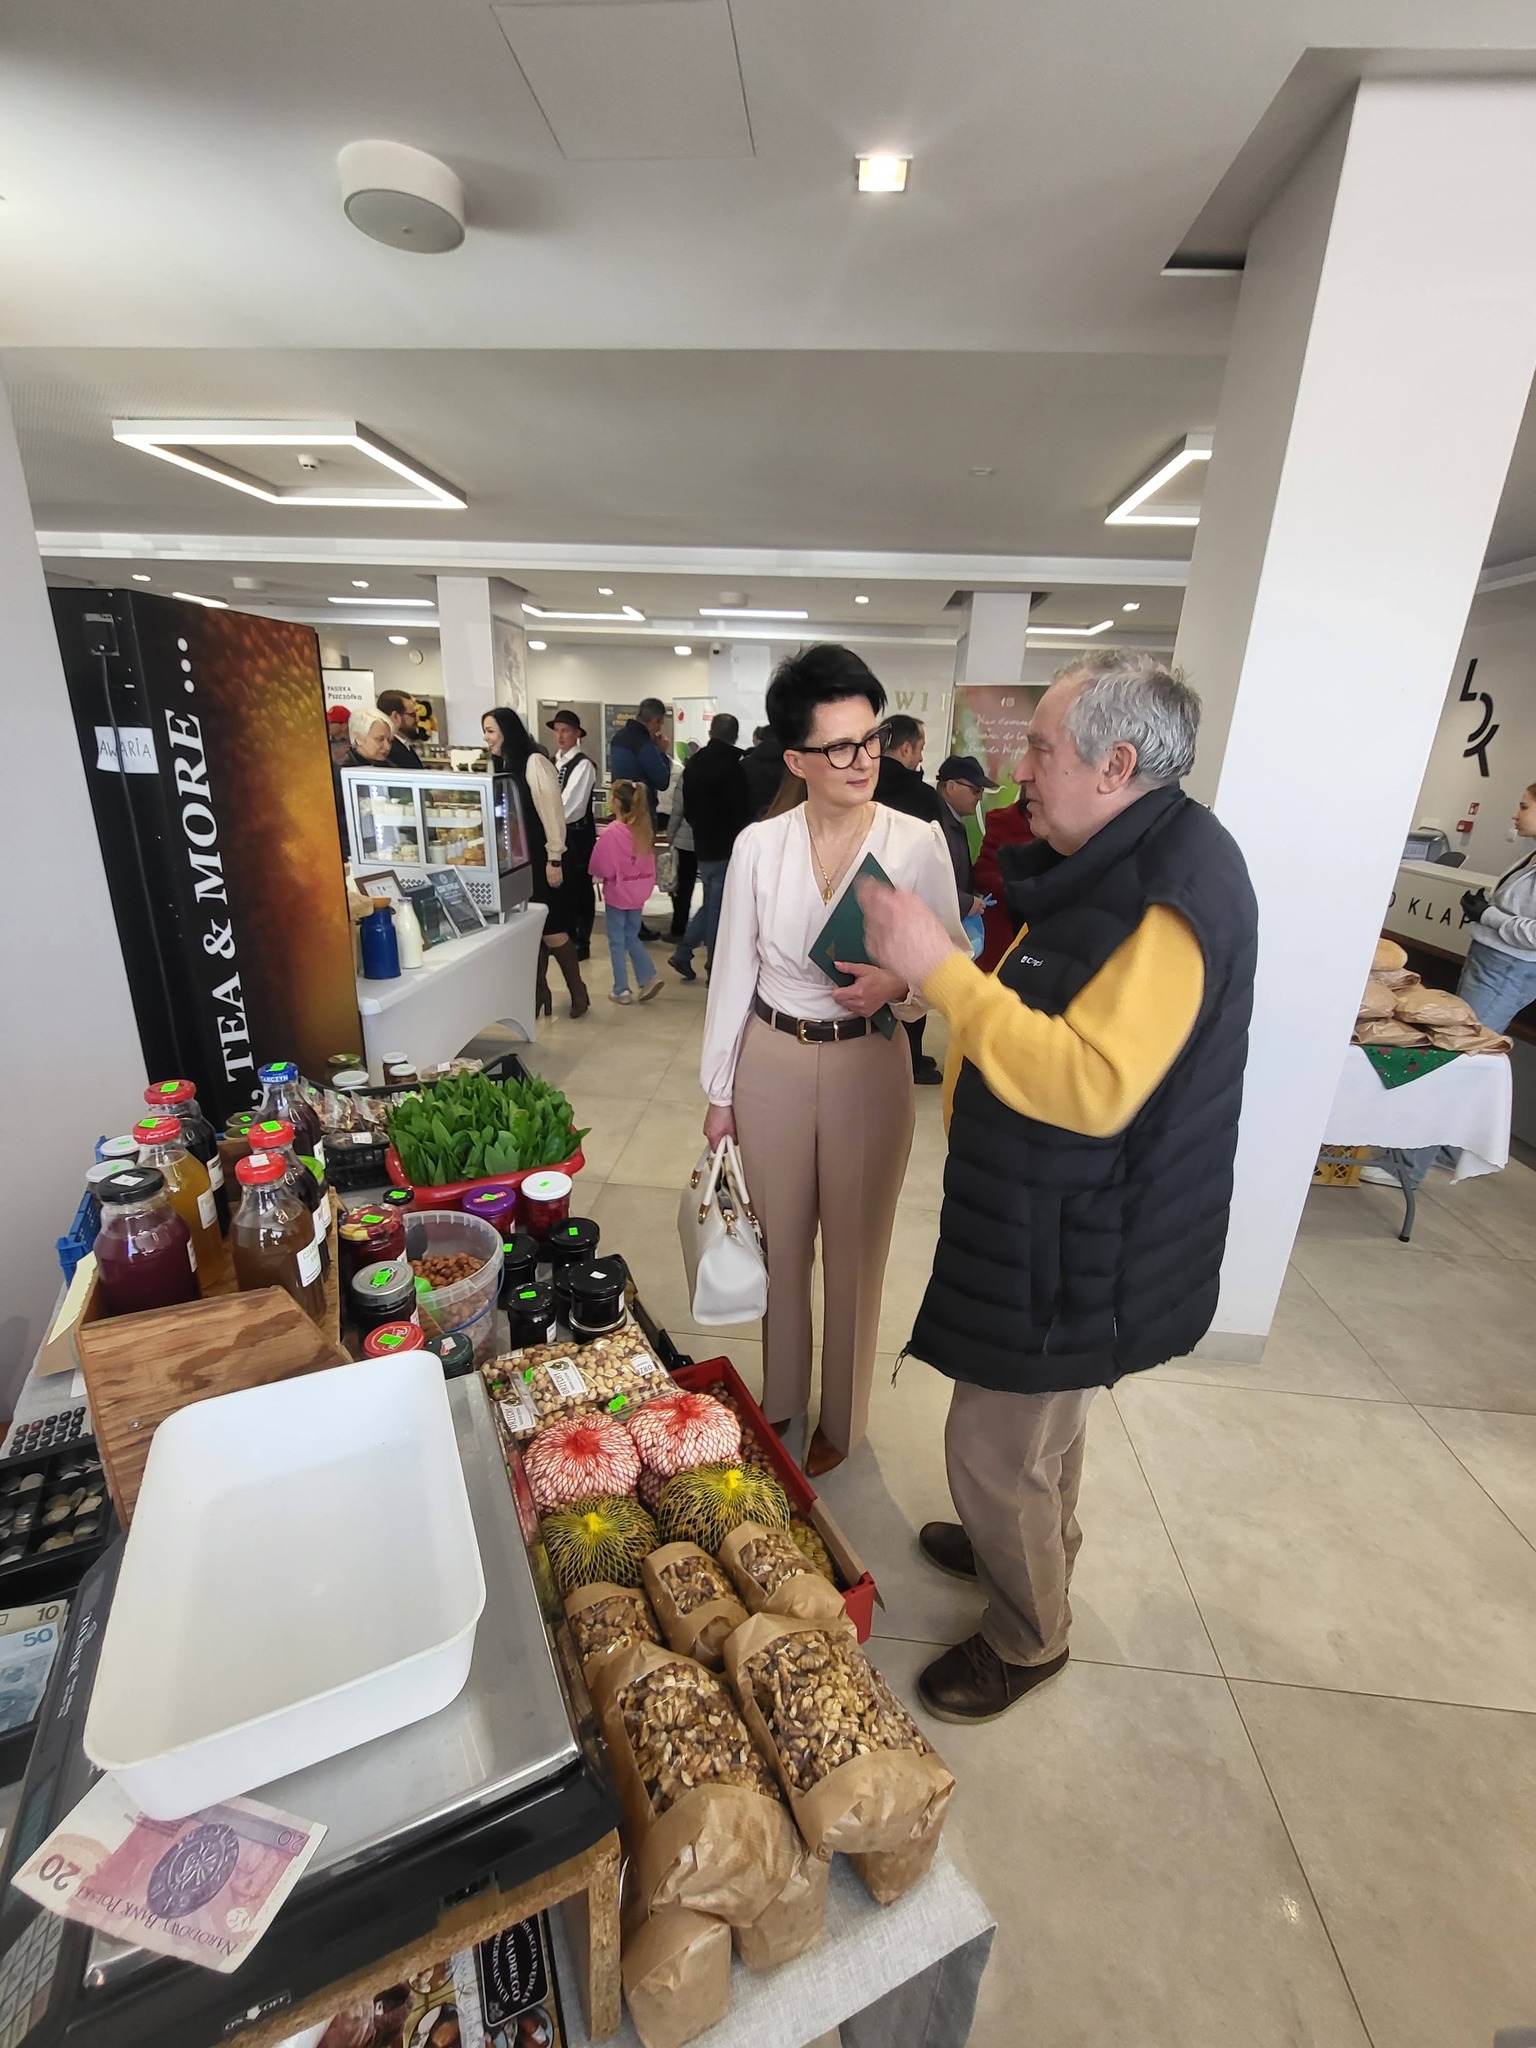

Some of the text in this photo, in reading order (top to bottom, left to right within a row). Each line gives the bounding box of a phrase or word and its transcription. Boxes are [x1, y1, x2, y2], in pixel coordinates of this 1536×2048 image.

[165, 709, 228, 904] MORE
[202, 918, 236, 960] &
[212, 971, 254, 1083] TEA
[37, 1605, 60, 1621] 10
[23, 1628, 53, 1647] 50
[277, 1830, 306, 1851] 20
[39, 1853, 82, 1891] 20
[505, 1933, 521, 2001] MĄDREGO
